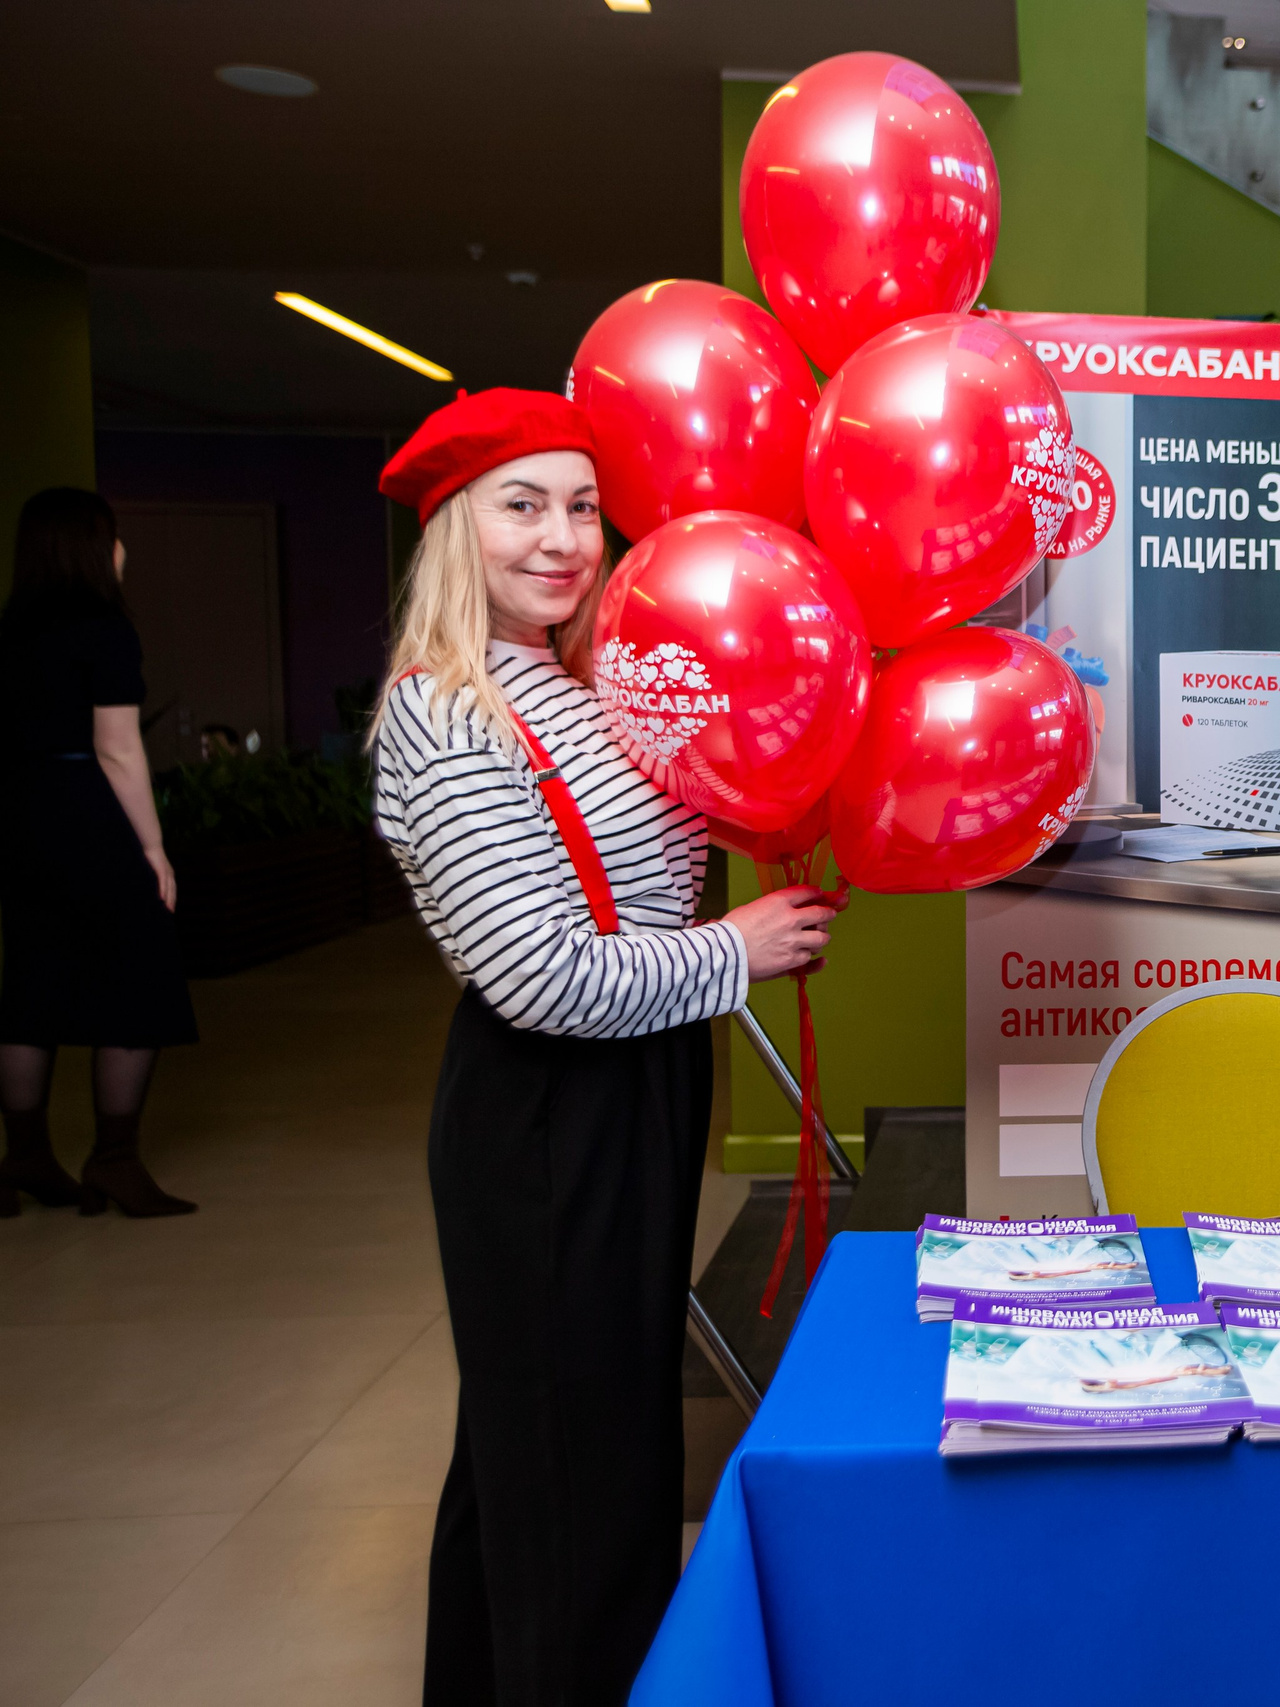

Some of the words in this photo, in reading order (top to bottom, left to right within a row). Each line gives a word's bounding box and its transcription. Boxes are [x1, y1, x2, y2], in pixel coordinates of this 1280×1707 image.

[1025, 340, 1280, 381] РУОКСАБАН
[1140, 436, 1200, 464] ЦЕНА
[1140, 484, 1249, 522] ЧИСЛО
[1068, 536, 1088, 552] НА
[1085, 494, 1111, 541] РЫНКЕ
[1181, 695, 1246, 705] РИВАРОКСАБАН
[1211, 718, 1249, 728] ТАБЛЕТОК
[1001, 951, 1119, 990] Самая
